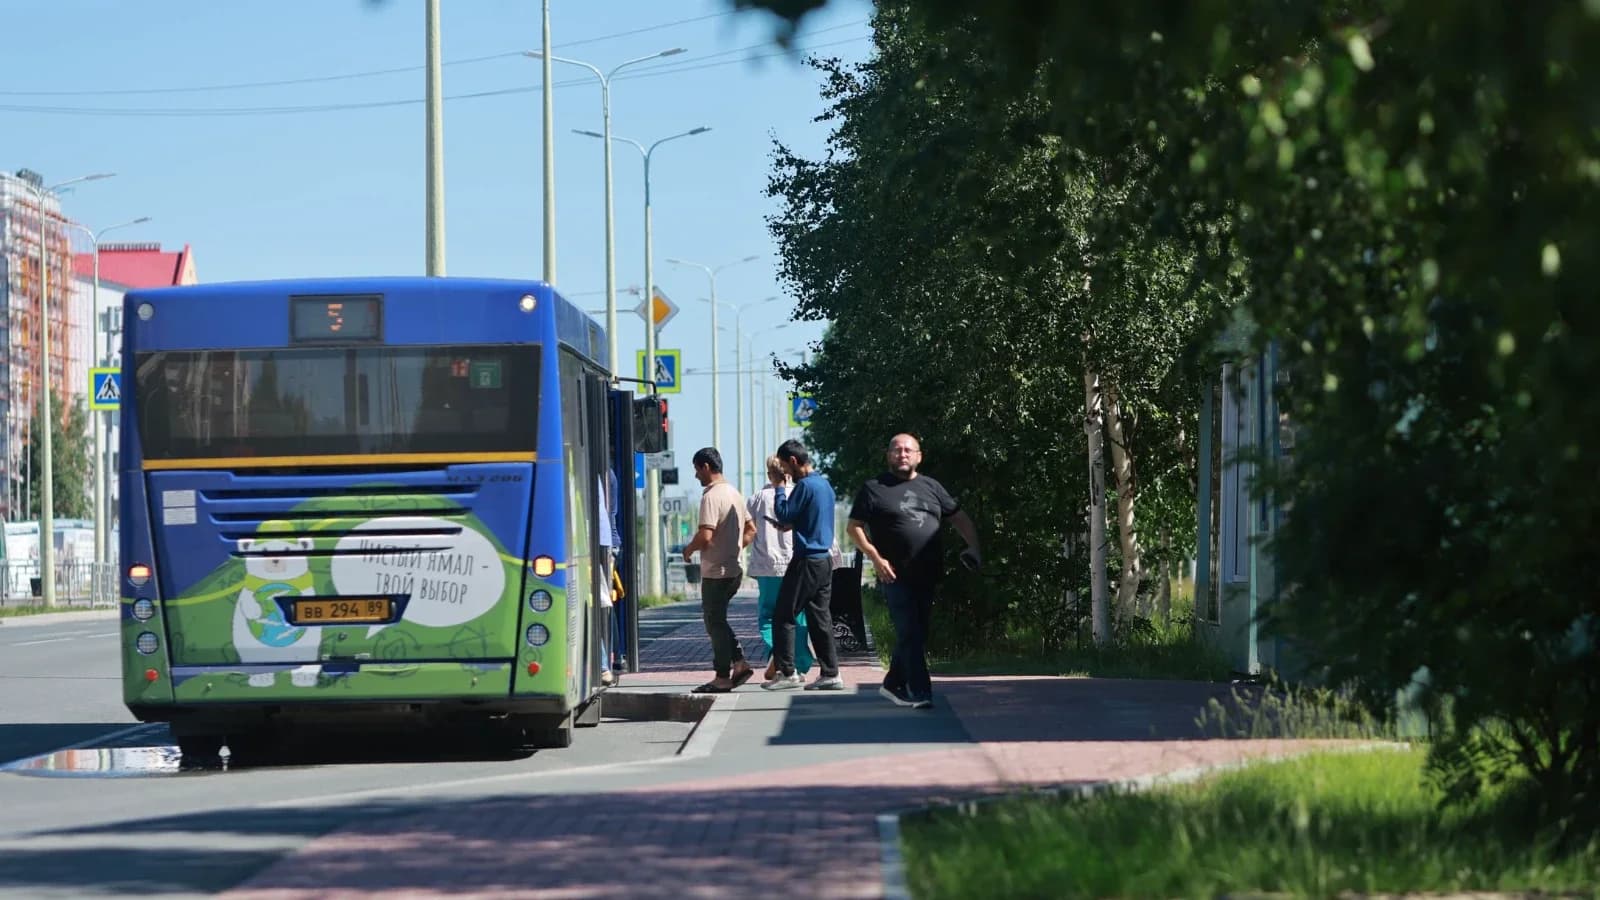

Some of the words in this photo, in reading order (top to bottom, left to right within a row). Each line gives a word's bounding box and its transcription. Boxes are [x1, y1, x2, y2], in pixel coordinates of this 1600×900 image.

[328, 303, 343, 331] 5
[662, 499, 682, 512] ОП
[360, 539, 422, 568] ЧИСТЫЙ
[427, 552, 475, 576] ЯМАЛ
[375, 572, 414, 595] ТВОЙ
[419, 578, 468, 604] ВЫБОР
[331, 603, 359, 618] 294
[368, 601, 383, 613] 89
